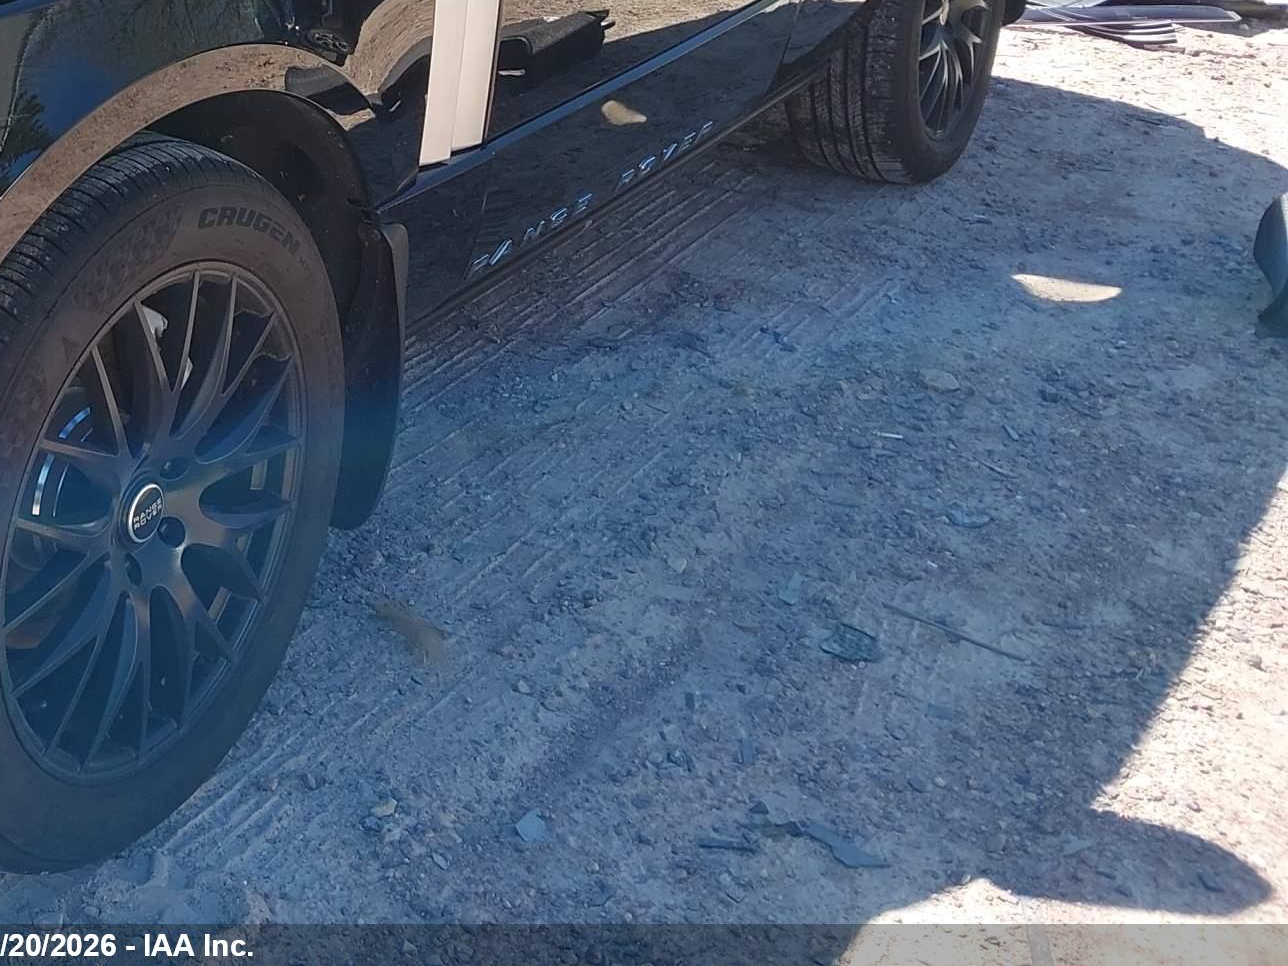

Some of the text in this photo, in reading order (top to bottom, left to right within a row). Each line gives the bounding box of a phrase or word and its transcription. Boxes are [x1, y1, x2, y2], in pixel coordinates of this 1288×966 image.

[198, 206, 301, 255] CRUGEN
[133, 497, 162, 524] RANGE
[133, 504, 162, 531] ROVER
